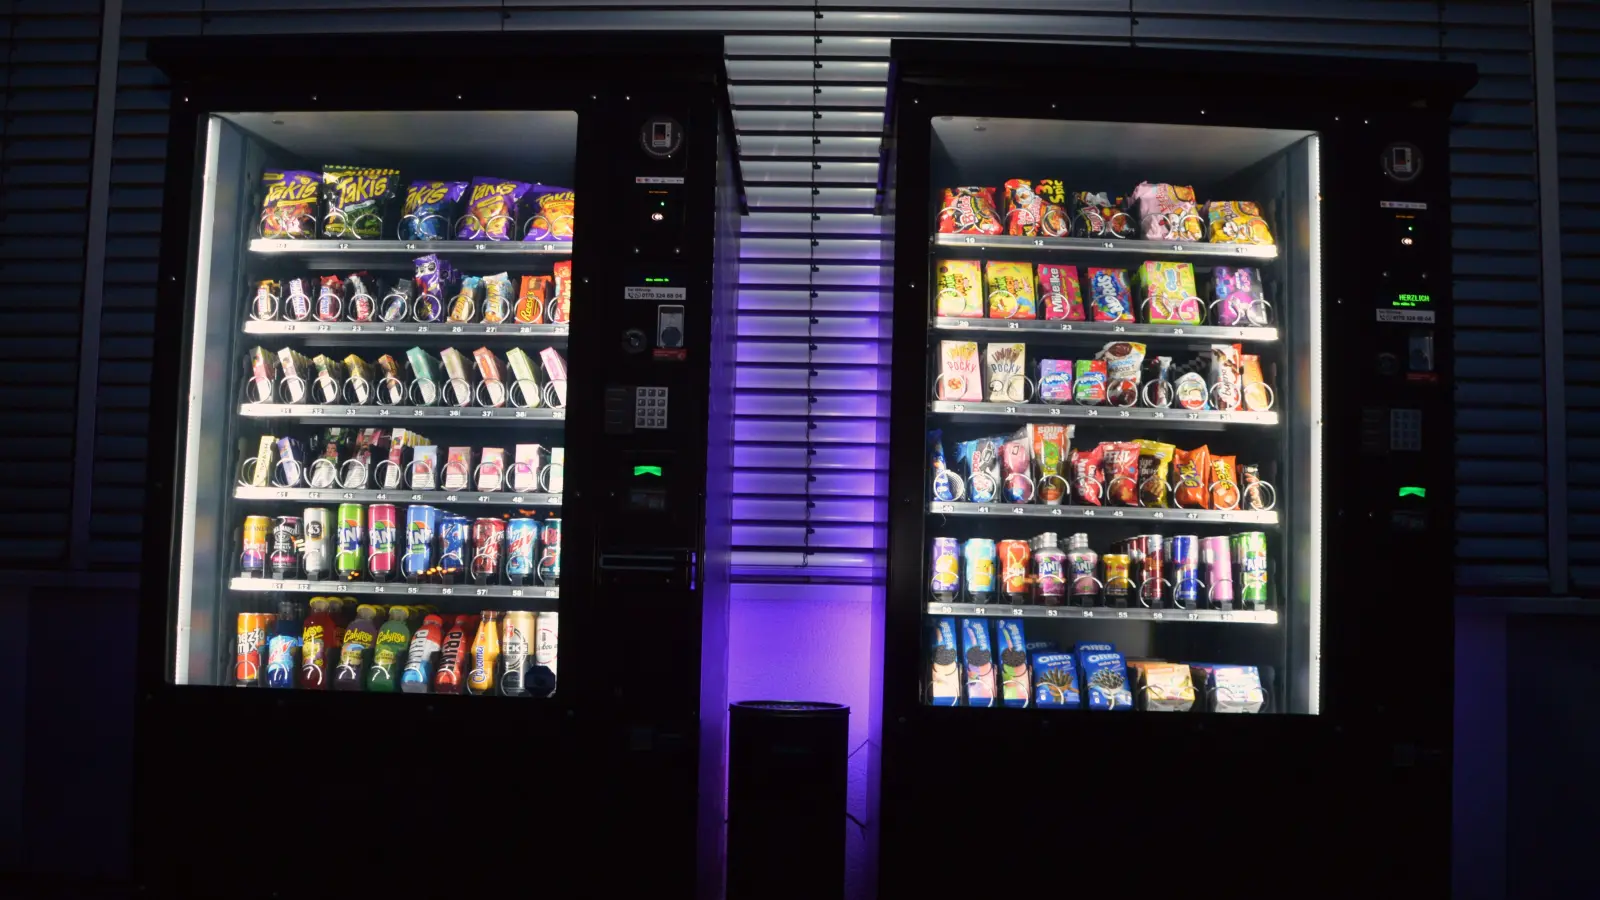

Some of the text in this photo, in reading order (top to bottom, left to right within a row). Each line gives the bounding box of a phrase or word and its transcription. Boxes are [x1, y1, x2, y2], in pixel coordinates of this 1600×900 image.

[264, 181, 318, 207] Takis
[336, 176, 388, 209] Takis
[1399, 294, 1429, 302] HERZLICH
[946, 361, 977, 373] POCKY
[990, 363, 1022, 375] POCKY
[1037, 654, 1072, 664] OREO
[1087, 653, 1121, 663] OREO
